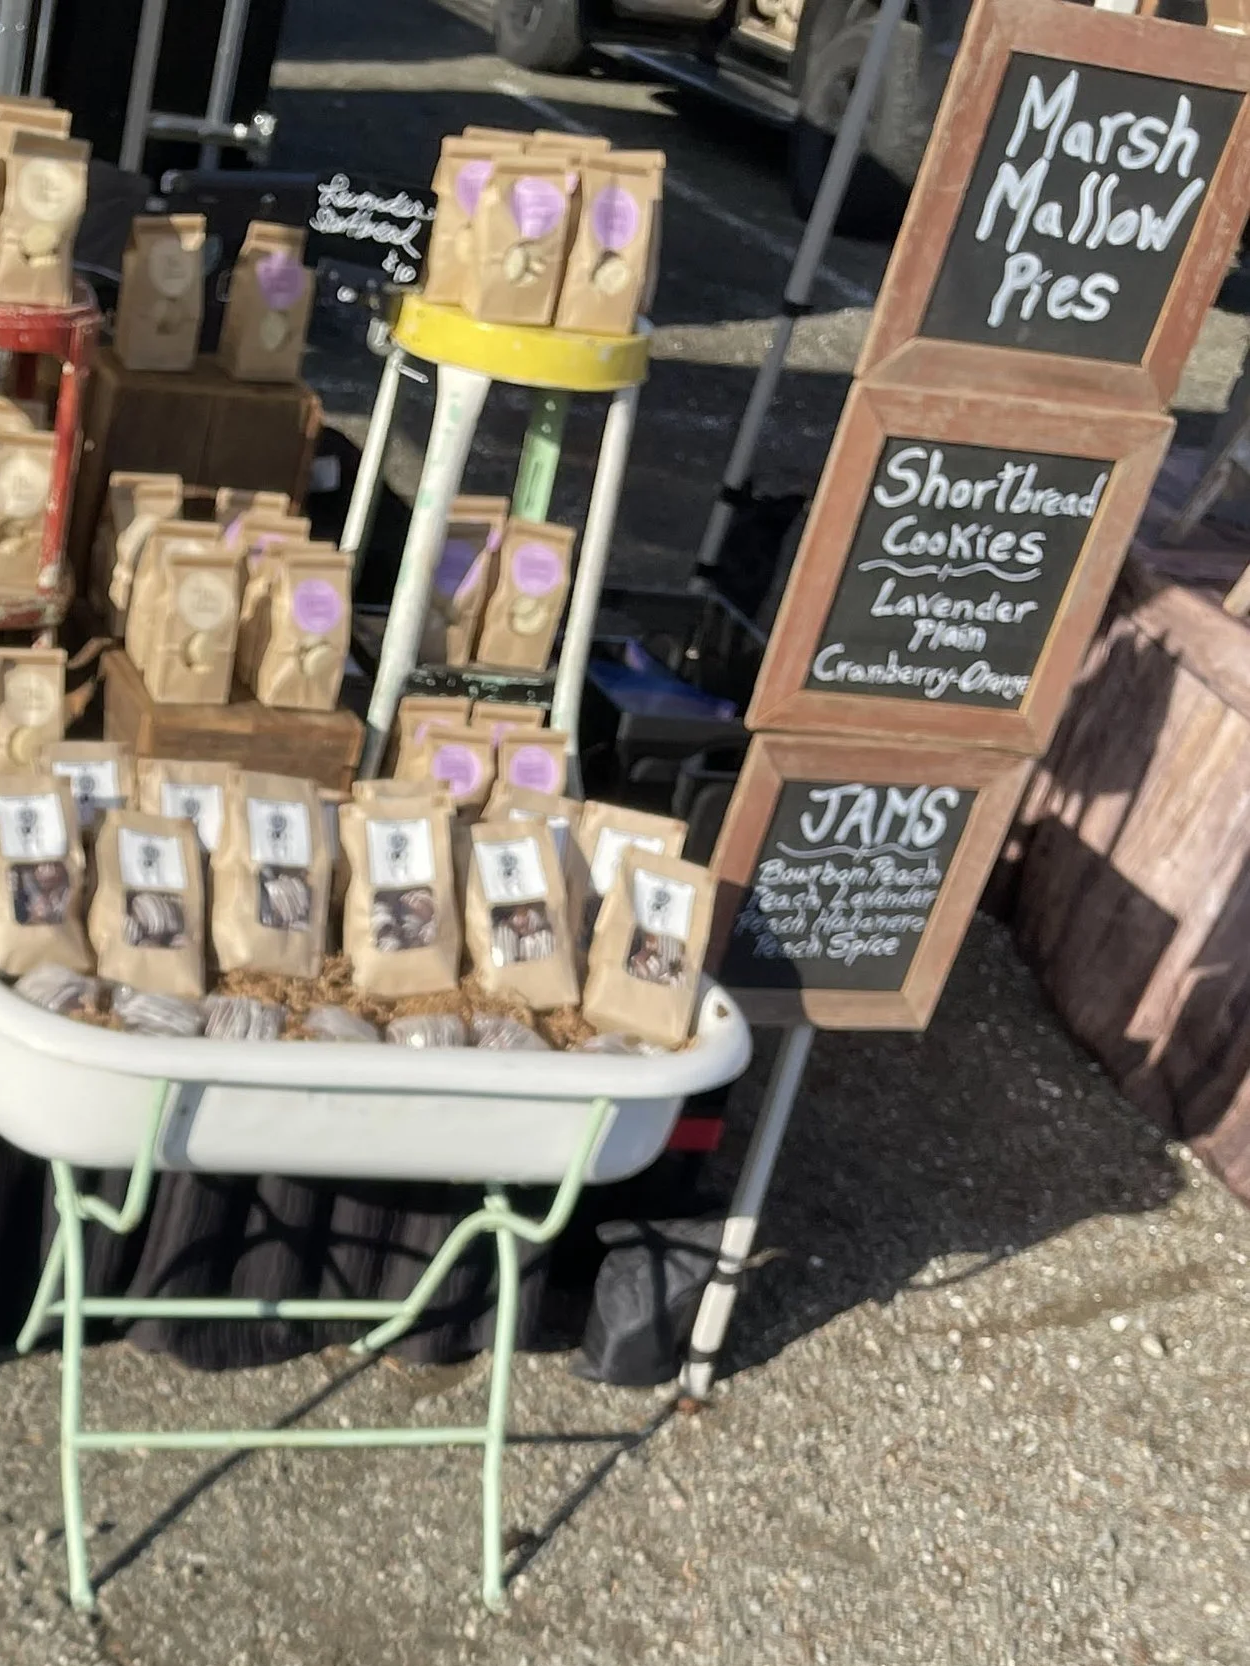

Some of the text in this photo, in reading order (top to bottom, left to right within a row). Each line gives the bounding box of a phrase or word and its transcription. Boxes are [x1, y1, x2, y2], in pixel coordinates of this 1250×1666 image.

[1005, 70, 1201, 178] Marsh
[975, 157, 1206, 253] Mallow
[381, 248, 417, 284] $10
[987, 252, 1120, 328] Pies
[873, 446, 1109, 518] Shortbread
[881, 514, 1047, 565] Cookies
[870, 577, 1039, 624] Lavender
[907, 618, 987, 653] Plain
[800, 783, 960, 848] JAMS
[758, 855, 943, 886] Bourbon Peach
[747, 882, 940, 913] Peach Lavender
[825, 931, 901, 967] Spice
